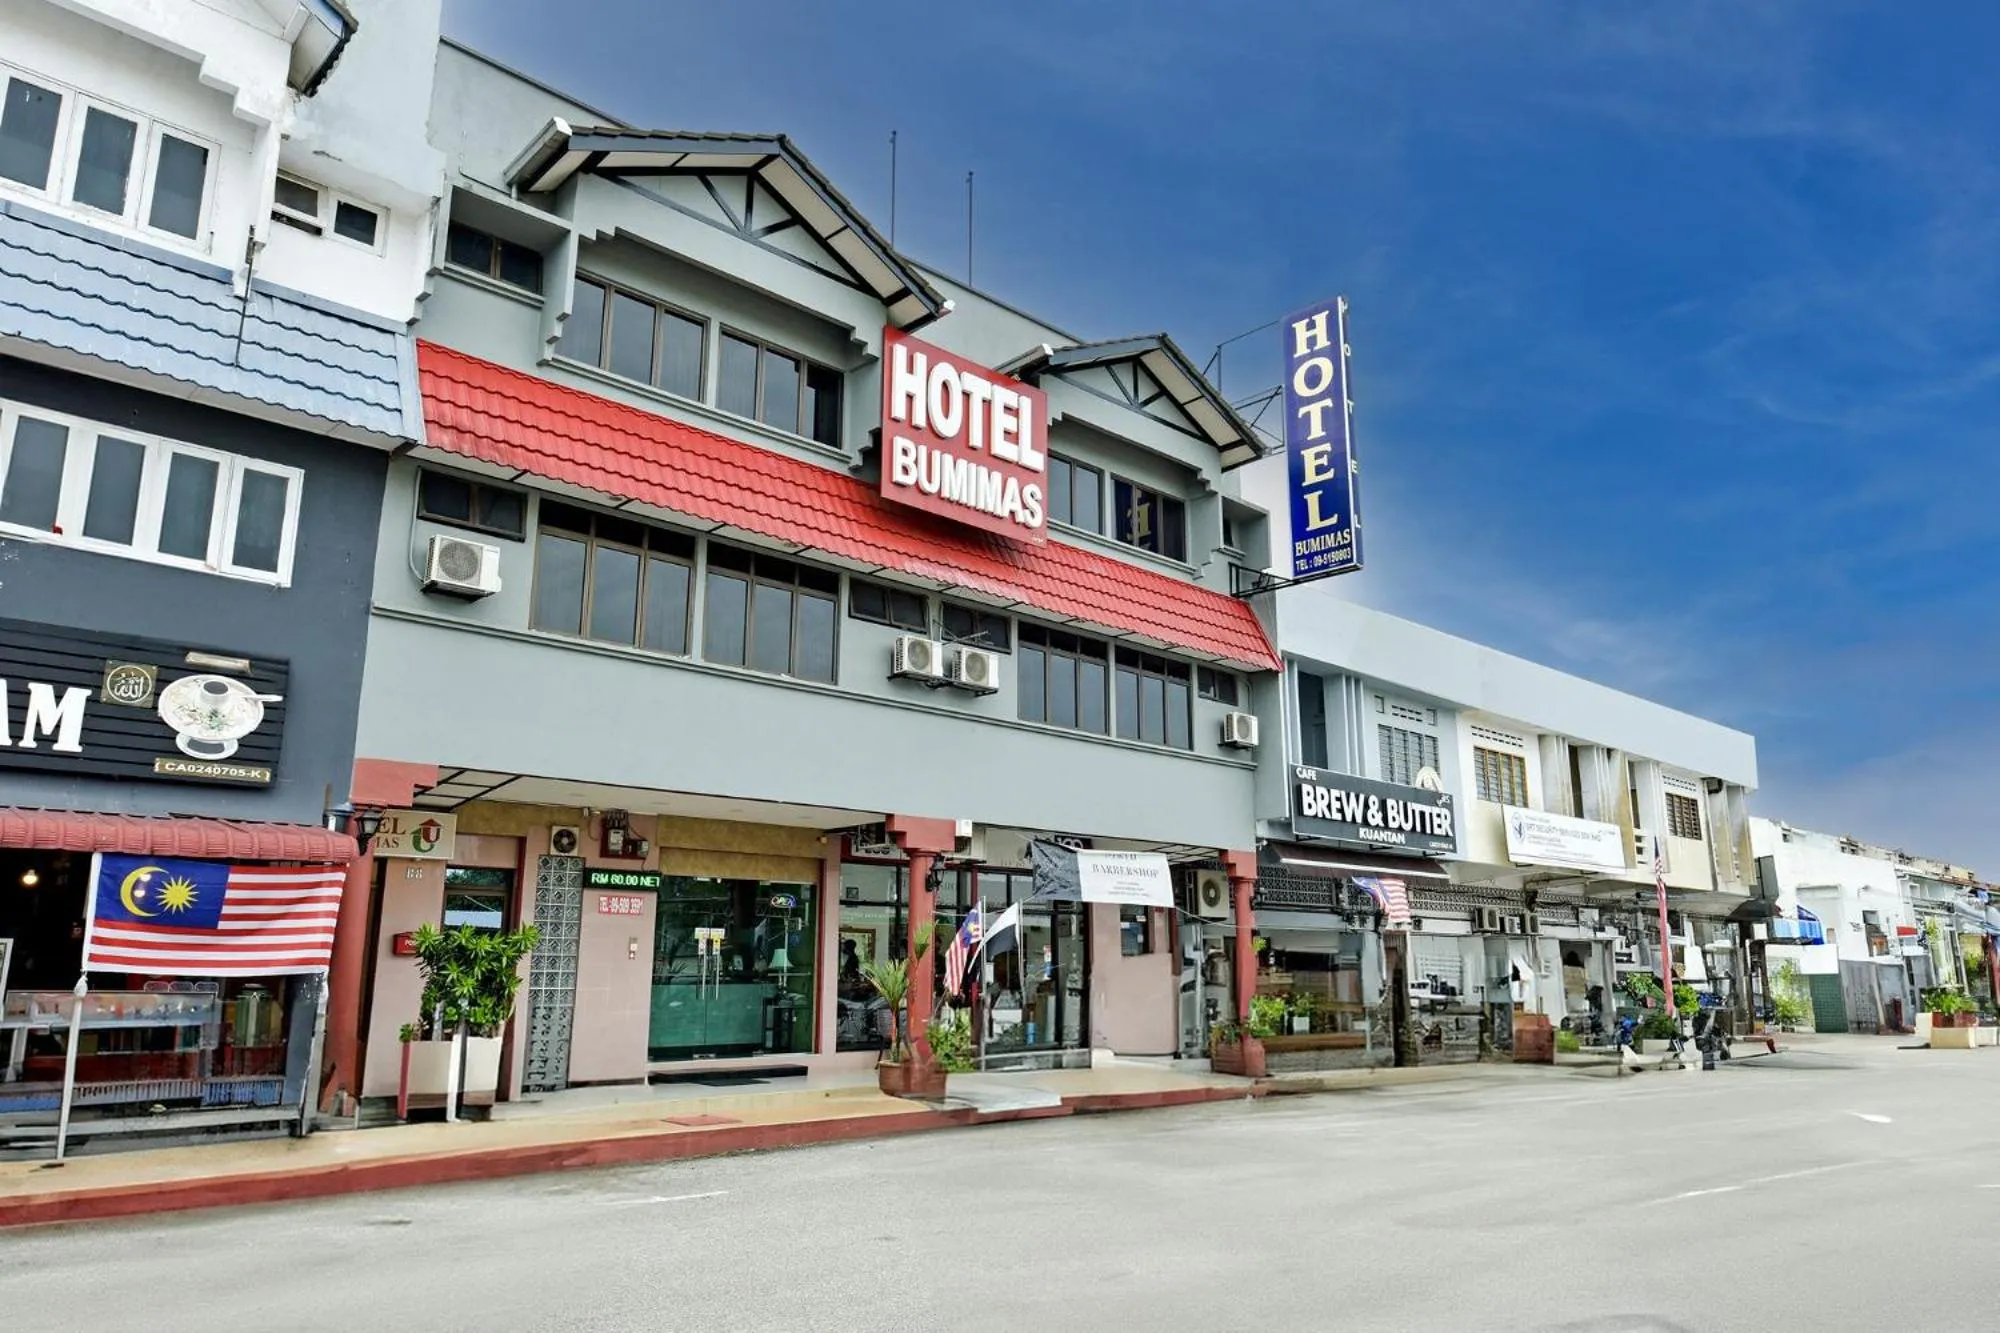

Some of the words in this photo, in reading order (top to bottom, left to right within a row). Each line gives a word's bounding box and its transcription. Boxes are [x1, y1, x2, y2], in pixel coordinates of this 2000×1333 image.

[891, 343, 1045, 473] HOTEL
[1292, 310, 1338, 532] HOTEL
[891, 435, 1043, 528] BUMIMAS
[1295, 529, 1351, 557] BUMIMAS
[1296, 767, 1317, 781] CAFE
[1301, 783, 1364, 824] BREW
[1367, 794, 1385, 827] &
[1386, 798, 1454, 837] BUTTER
[1359, 827, 1406, 844] KUANTAN
[640, 876, 660, 888] NET
